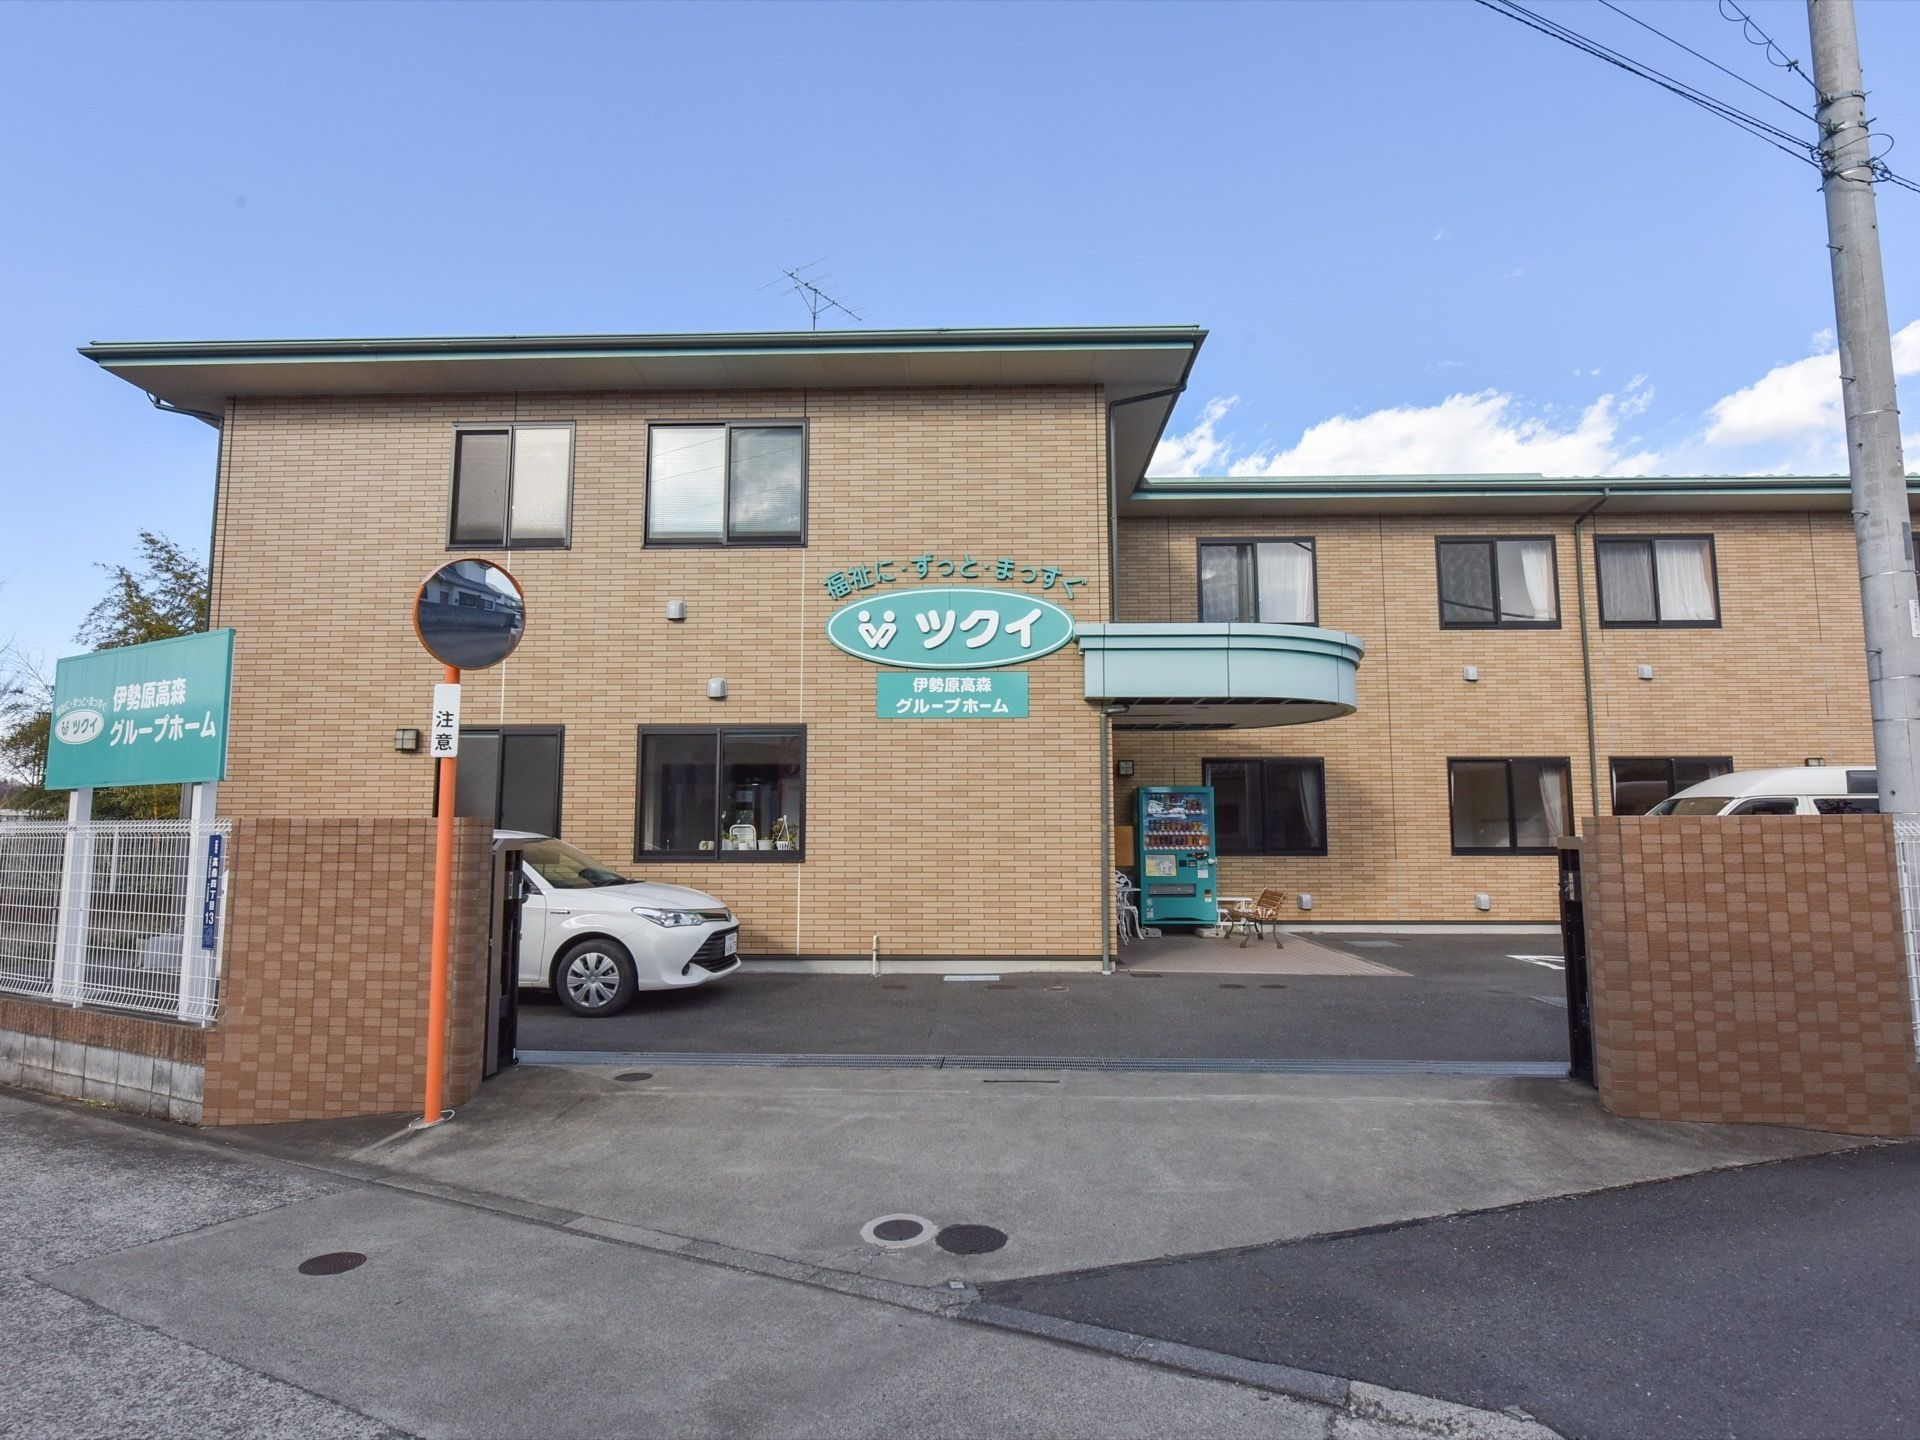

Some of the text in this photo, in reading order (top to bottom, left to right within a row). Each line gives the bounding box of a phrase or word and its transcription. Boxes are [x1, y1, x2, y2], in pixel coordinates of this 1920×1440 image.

[823, 553, 1088, 600] 福祉に・ずっと・まっすぐ
[914, 608, 1042, 649] ツクイ
[113, 677, 187, 712] 伊勢原高森
[912, 677, 992, 693] 伊勢原高森
[896, 698, 1009, 714] グループホーム
[73, 717, 98, 735] ツクイ
[110, 710, 216, 746] グループホーム
[435, 711, 454, 751] 注意
